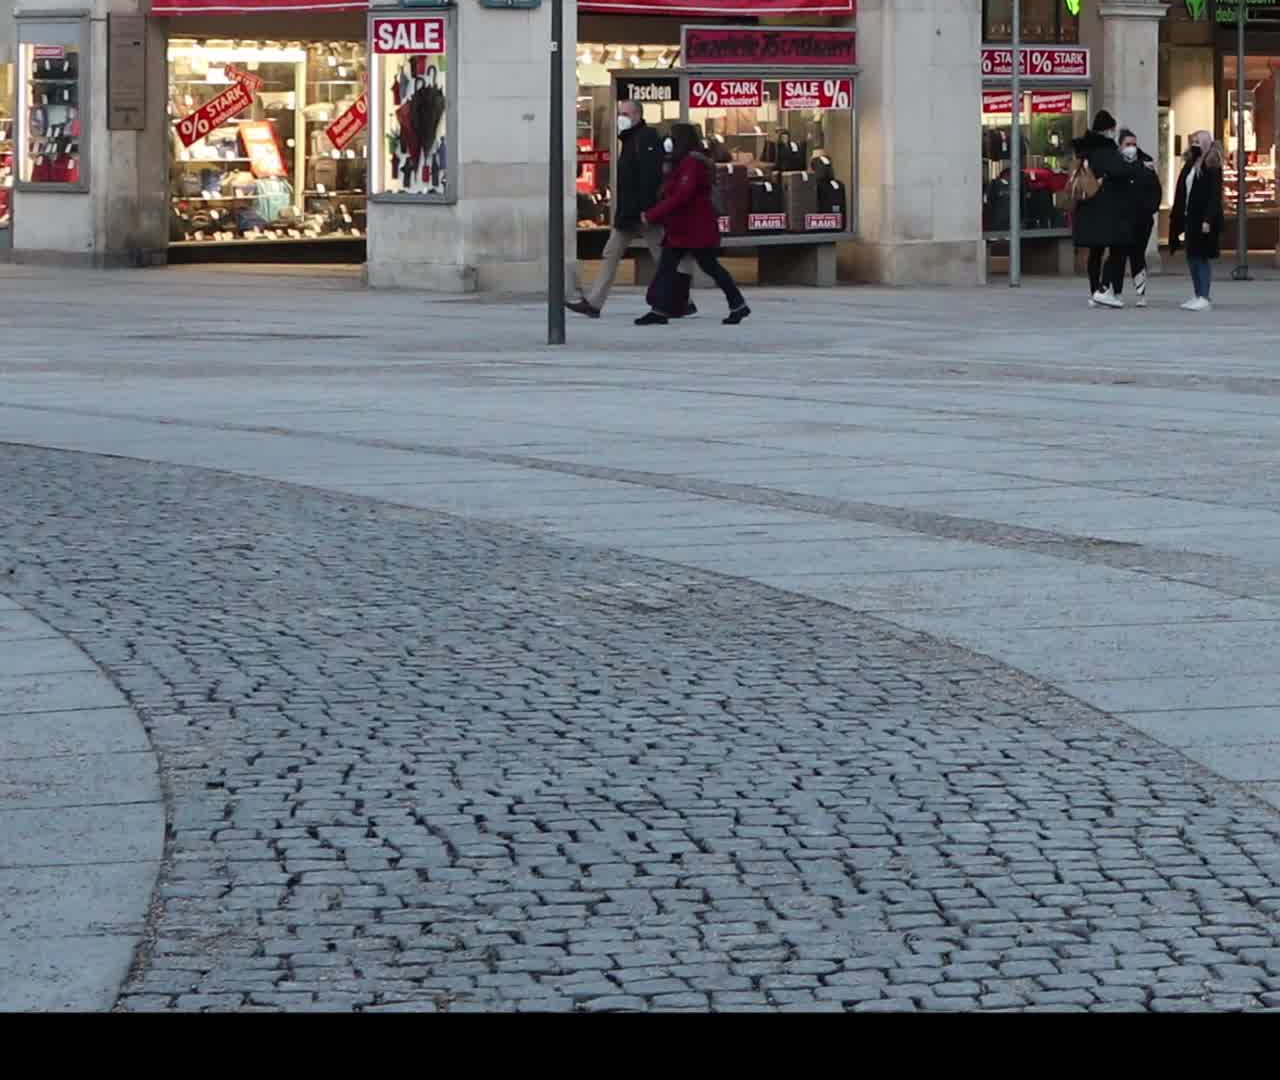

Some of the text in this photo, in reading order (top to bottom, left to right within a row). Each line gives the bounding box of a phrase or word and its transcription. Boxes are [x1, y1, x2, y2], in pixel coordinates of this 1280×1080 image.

[378, 22, 440, 50] SALE
[994, 51, 1024, 63] STAK
[1054, 52, 1084, 64] STARK
[628, 83, 672, 101] Taschen
[693, 81, 758, 106] % STARK
[785, 82, 819, 96] SALE
[206, 87, 245, 118] STARK
[720, 96, 759, 106] reduziert!
